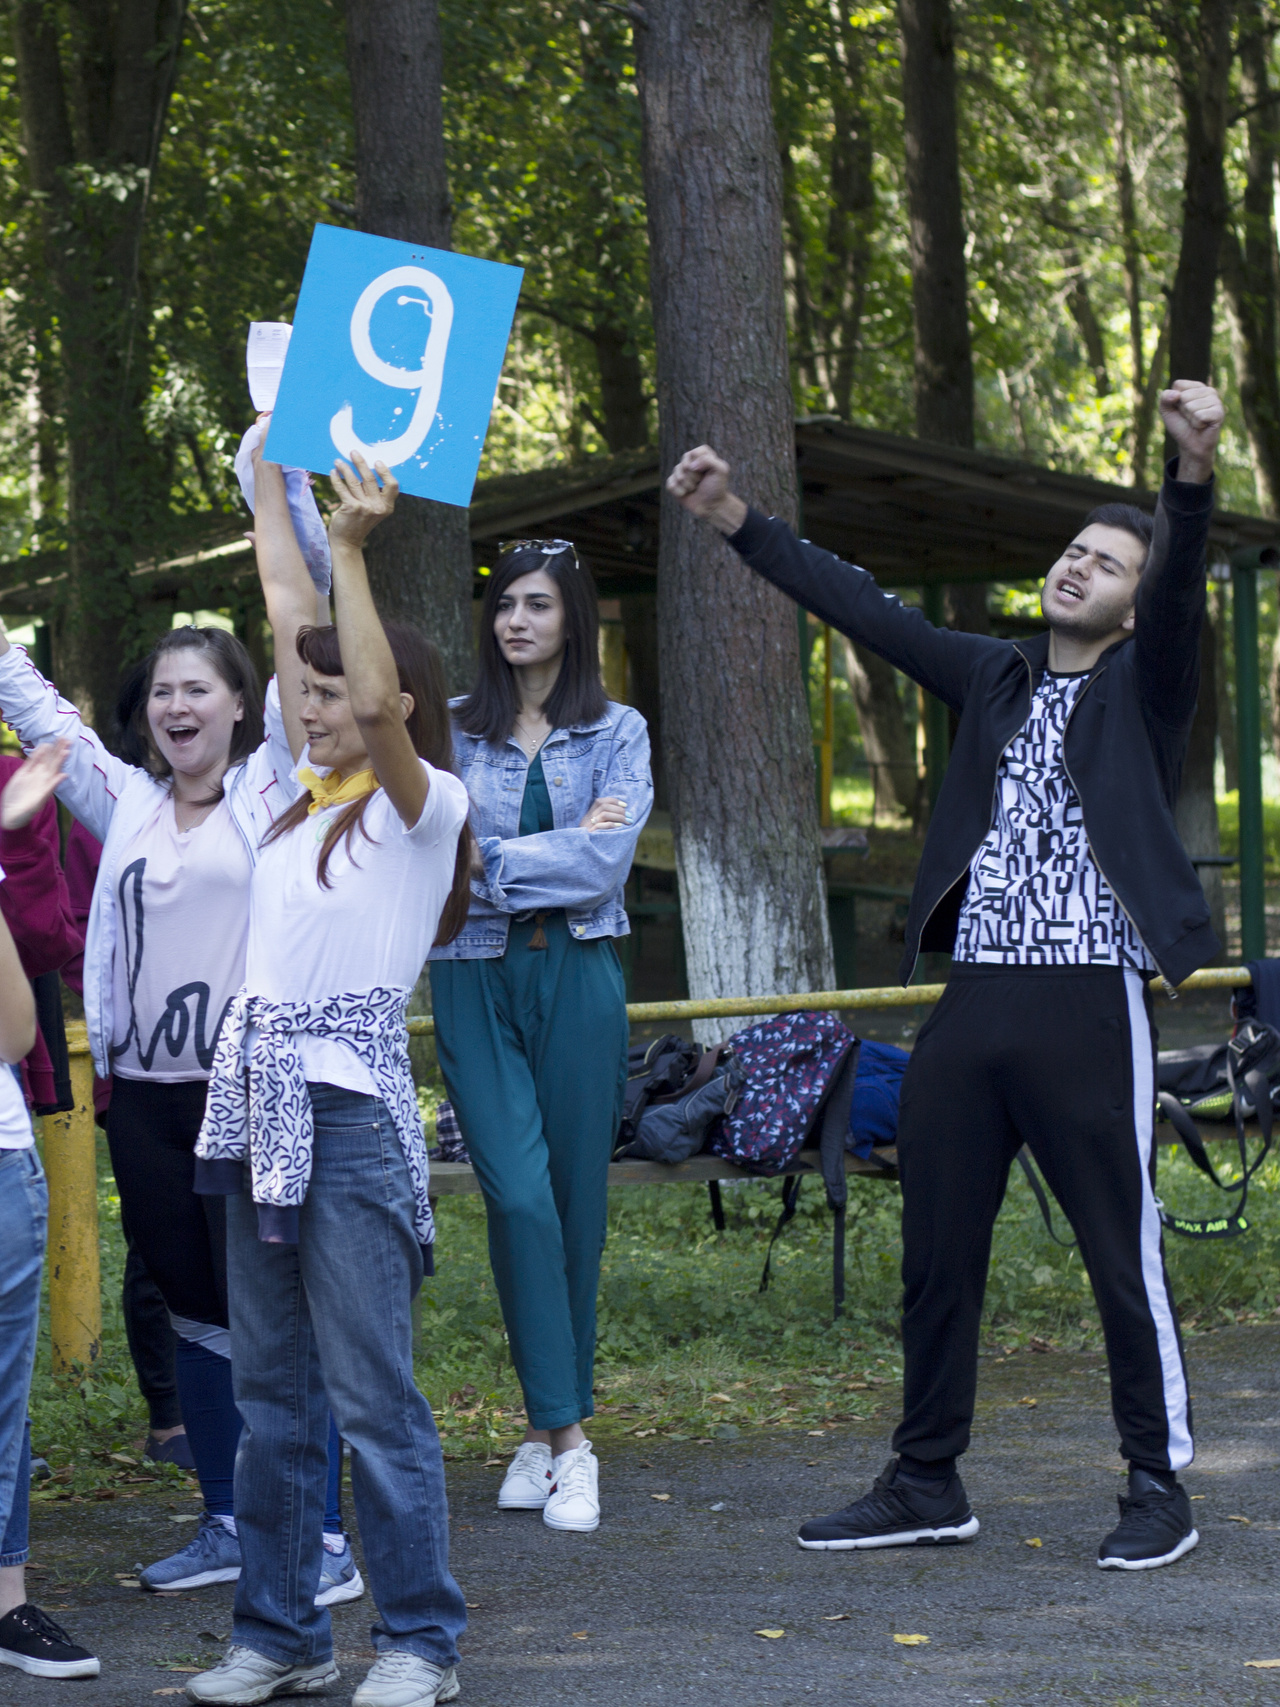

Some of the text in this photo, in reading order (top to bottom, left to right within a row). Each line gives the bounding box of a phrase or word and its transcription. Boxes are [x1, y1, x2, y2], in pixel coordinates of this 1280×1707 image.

[330, 265, 454, 468] 9
[1174, 1219, 1228, 1233] MAX AIR
